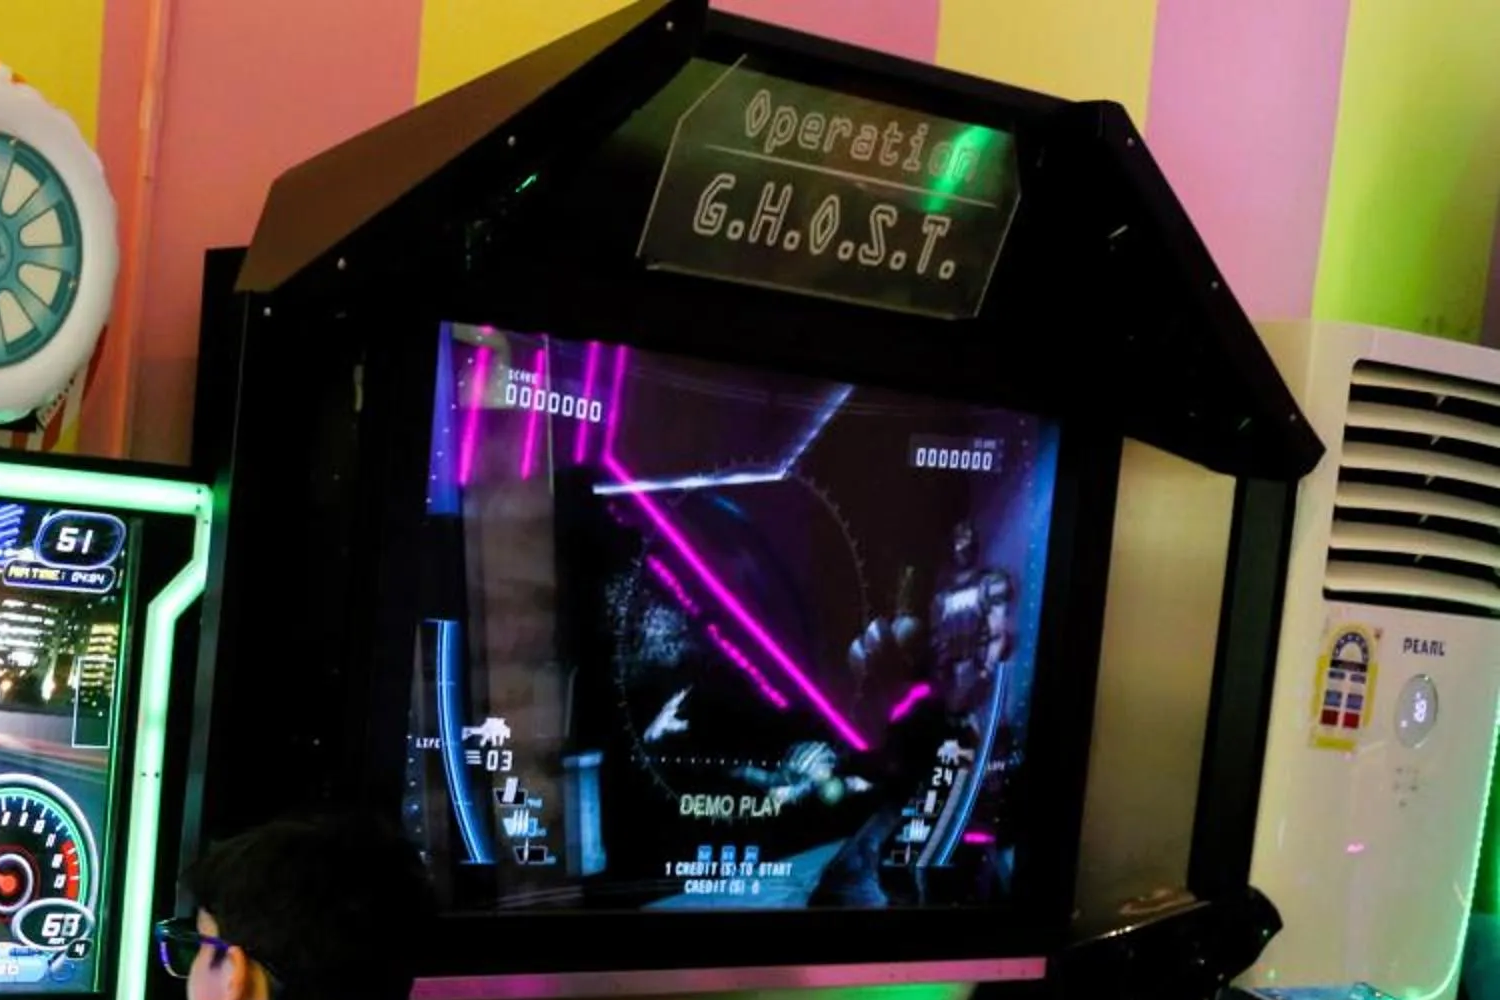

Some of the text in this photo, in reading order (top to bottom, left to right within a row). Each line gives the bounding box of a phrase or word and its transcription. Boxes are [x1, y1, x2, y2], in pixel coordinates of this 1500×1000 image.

[745, 88, 981, 181] Operation
[693, 172, 957, 281] G.H.O.S.T.
[505, 382, 602, 423] 0000000
[915, 446, 993, 471] 0000000
[1403, 636, 1446, 657] PEARL
[486, 749, 513, 772] 03
[931, 766, 953, 787] 24
[679, 793, 781, 818] DEMO PLAY
[675, 861, 718, 877] CREDIT
[758, 861, 793, 877] START
[684, 879, 727, 895] CREDIT
